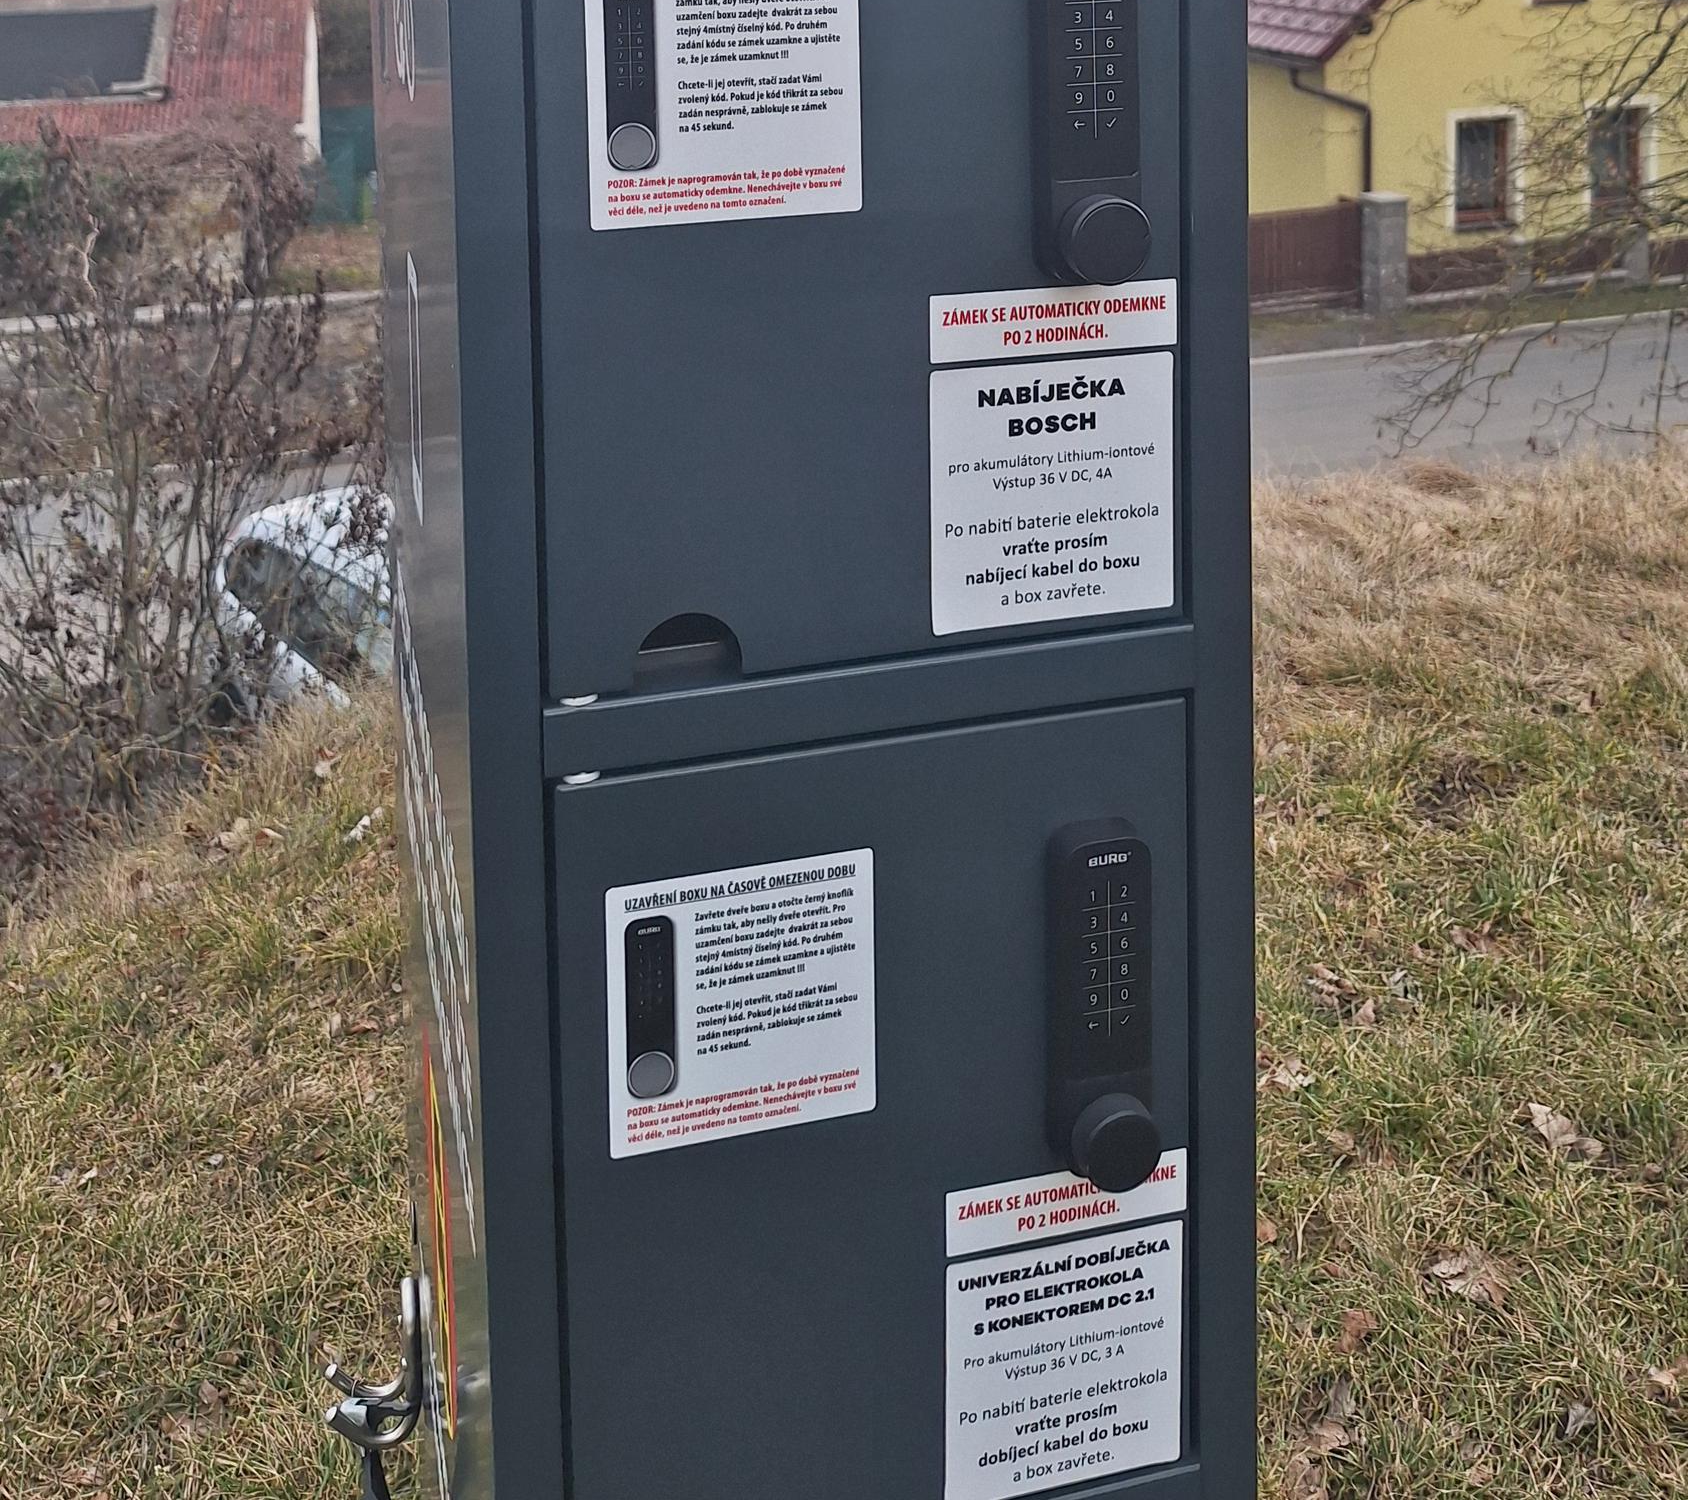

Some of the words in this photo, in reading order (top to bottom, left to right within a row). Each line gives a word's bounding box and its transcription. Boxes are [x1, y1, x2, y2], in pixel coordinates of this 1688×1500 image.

[785, 21, 795, 31] Po
[1074, 11, 1082, 24] 3
[1105, 10, 1114, 22] 4
[1075, 38, 1083, 51] 5
[1106, 36, 1114, 49] 6
[1075, 66, 1082, 78] 7
[1106, 64, 1115, 76] 8
[1075, 92, 1083, 104] 9
[1106, 90, 1115, 102] 0
[678, 125, 690, 133] na
[690, 122, 701, 132] 45
[702, 120, 735, 132] sekund.
[607, 178, 638, 189] POZOR:
[667, 176, 676, 188] je
[743, 170, 760, 181] tak,
[771, 170, 782, 181] po
[942, 307, 989, 327] ZÁMEK
[991, 307, 1007, 323] SE
[1009, 299, 1101, 322] AUTOMATICKY
[1103, 295, 1167, 315] ODEMKNE
[1003, 330, 1021, 346] PO
[1024, 329, 1033, 345] 2
[1035, 323, 1109, 344] HODINÁCH.
[978, 377, 1126, 408] NABÍJEČKA
[1008, 411, 1096, 438] BOSCH
[948, 463, 970, 477] pro
[973, 453, 1054, 472] akumulátory
[1057, 442, 1155, 464] Lithium-iontové
[992, 476, 1036, 492] Výstup
[1039, 472, 1055, 486] 36
[1058, 470, 1068, 484] V
[1071, 468, 1092, 483] DC,
[1095, 467, 1113, 480] 4A
[945, 523, 964, 539] Po
[968, 515, 1013, 536] nabití
[1017, 511, 1071, 531] baterie
[1076, 502, 1159, 525] elektrokola
[1002, 537, 1050, 557] vraťte
[1054, 532, 1108, 555] prosím
[965, 563, 1028, 586] nabíjecí
[1031, 558, 1074, 579] kabel
[1078, 557, 1098, 573] do
[1102, 555, 1140, 571] boxu
[1000, 594, 1009, 606] a
[1014, 589, 1042, 605] box
[1046, 582, 1106, 601] zavřete.
[624, 889, 677, 911] UZAVŘENÍ
[679, 886, 708, 903] BOXU
[710, 884, 725, 898] NA
[727, 876, 766, 895] ČASOVĚ
[769, 869, 825, 888] OMEZENOU
[827, 863, 856, 879] DOBU
[958, 1198, 1004, 1221] ZÁMEK
[1006, 1194, 1021, 1212] SE
[1024, 1182, 1102, 1209] AUTOMATIC
[1017, 1215, 1036, 1232] PO
[1038, 1213, 1046, 1228] 2
[1049, 1198, 1120, 1226] HODINÁCH.
[958, 1254, 1073, 1292] UNIVERZÁLNÍ
[1074, 1239, 1171, 1270] DOBÍJEČKA
[985, 1292, 1021, 1311] PRO
[1023, 1267, 1144, 1303] ELEKTROKOLA
[974, 1322, 985, 1336] S
[988, 1297, 1105, 1334] KONEKTOREM
[1107, 1292, 1132, 1309] DC
[1134, 1287, 1155, 1303] 2.1
[963, 1357, 985, 1370] Pro
[987, 1339, 1066, 1365] akumulátory
[1069, 1316, 1165, 1348] Lithium-iontové
[1004, 1363, 1047, 1381] Výstup
[1050, 1356, 1066, 1371] 36
[1068, 1353, 1078, 1366] V
[1081, 1349, 1102, 1364] DC,
[1105, 1346, 1113, 1359] 3
[1115, 1344, 1125, 1357] A
[959, 1411, 978, 1426] Po
[982, 1397, 1026, 1421] nabití
[1029, 1387, 1083, 1411] baterie
[1086, 1369, 1168, 1398] elektrokola
[1015, 1414, 1061, 1436] vraťte
[1065, 1402, 1118, 1429] prosím
[978, 1439, 1040, 1468] dobíjecí
[1043, 1430, 1084, 1453] kabel
[1088, 1426, 1108, 1443] do
[1112, 1419, 1149, 1437] boxu
[1012, 1471, 1021, 1483] a
[1026, 1463, 1053, 1480] box
[1057, 1450, 1115, 1473] zavřete.
